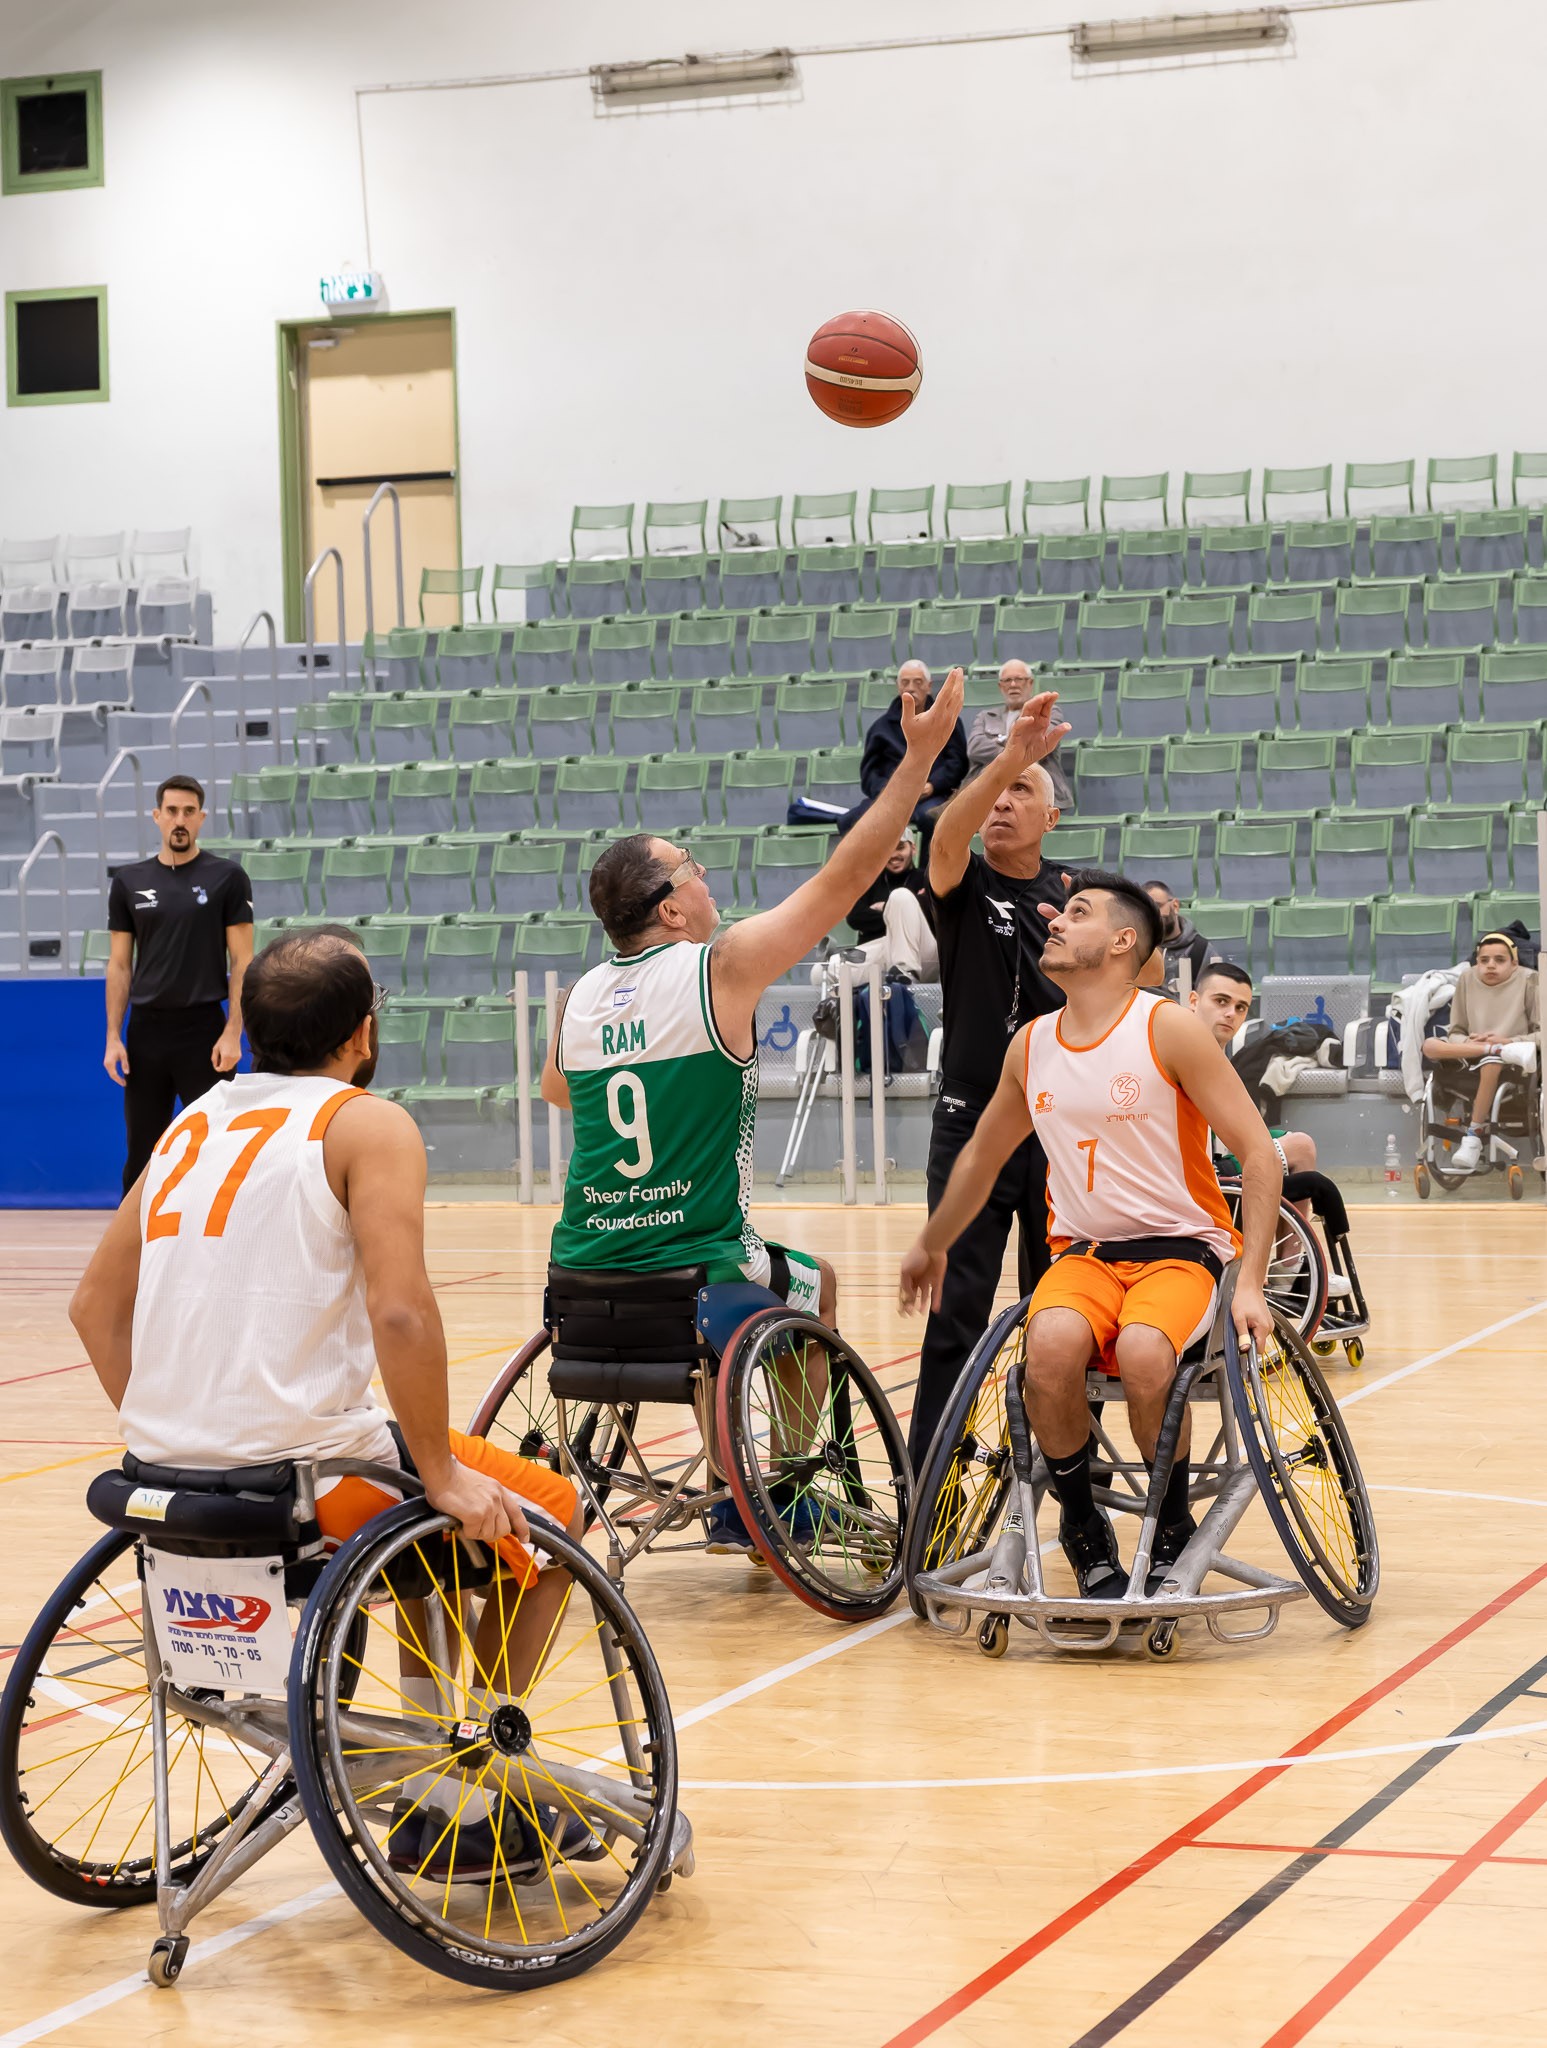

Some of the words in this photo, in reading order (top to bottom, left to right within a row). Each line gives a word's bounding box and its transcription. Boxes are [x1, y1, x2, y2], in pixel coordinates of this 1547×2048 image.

[602, 1019, 646, 1056] RAM
[606, 1070, 654, 1179] 9
[146, 1107, 292, 1243] 27
[1077, 1138, 1099, 1193] 7
[583, 1186, 627, 1204] Shear
[629, 1179, 692, 1203] Family
[586, 1209, 685, 1231] Foundation
[171, 1640, 194, 1654] 1700
[201, 1644, 216, 1657] 70
[223, 1646, 238, 1659] 70
[247, 1648, 262, 1661] 05
[446, 1946, 557, 1971] SPINERGY
